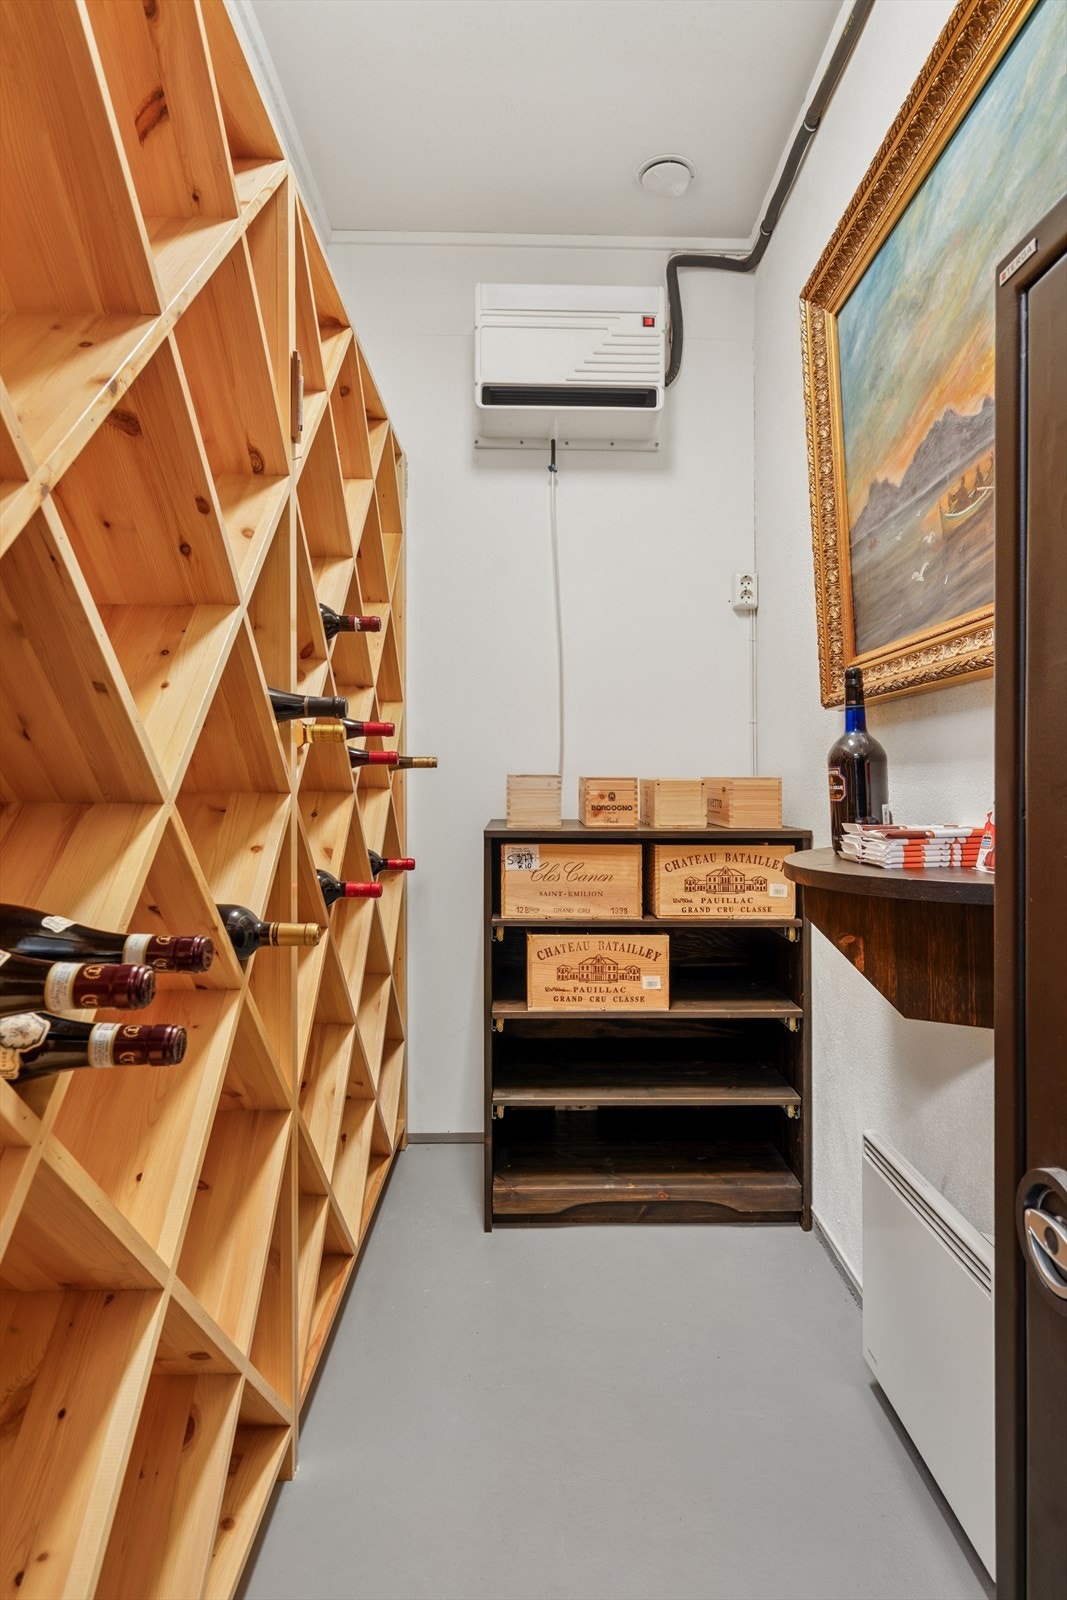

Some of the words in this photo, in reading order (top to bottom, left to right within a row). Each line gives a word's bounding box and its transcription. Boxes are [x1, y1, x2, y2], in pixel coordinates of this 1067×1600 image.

[664, 852, 717, 873] CHATEAU
[530, 861, 561, 882] Clos
[563, 861, 615, 882] Canon
[539, 890, 604, 898] SAINT-EMILION
[681, 906, 711, 914] GRAND
[717, 906, 734, 914] CRU
[740, 906, 773, 914] CLASSE
[536, 940, 590, 961] CHATEAU
[598, 940, 662, 962] BATAILLEY
[573, 986, 627, 994] PAUILLAC
